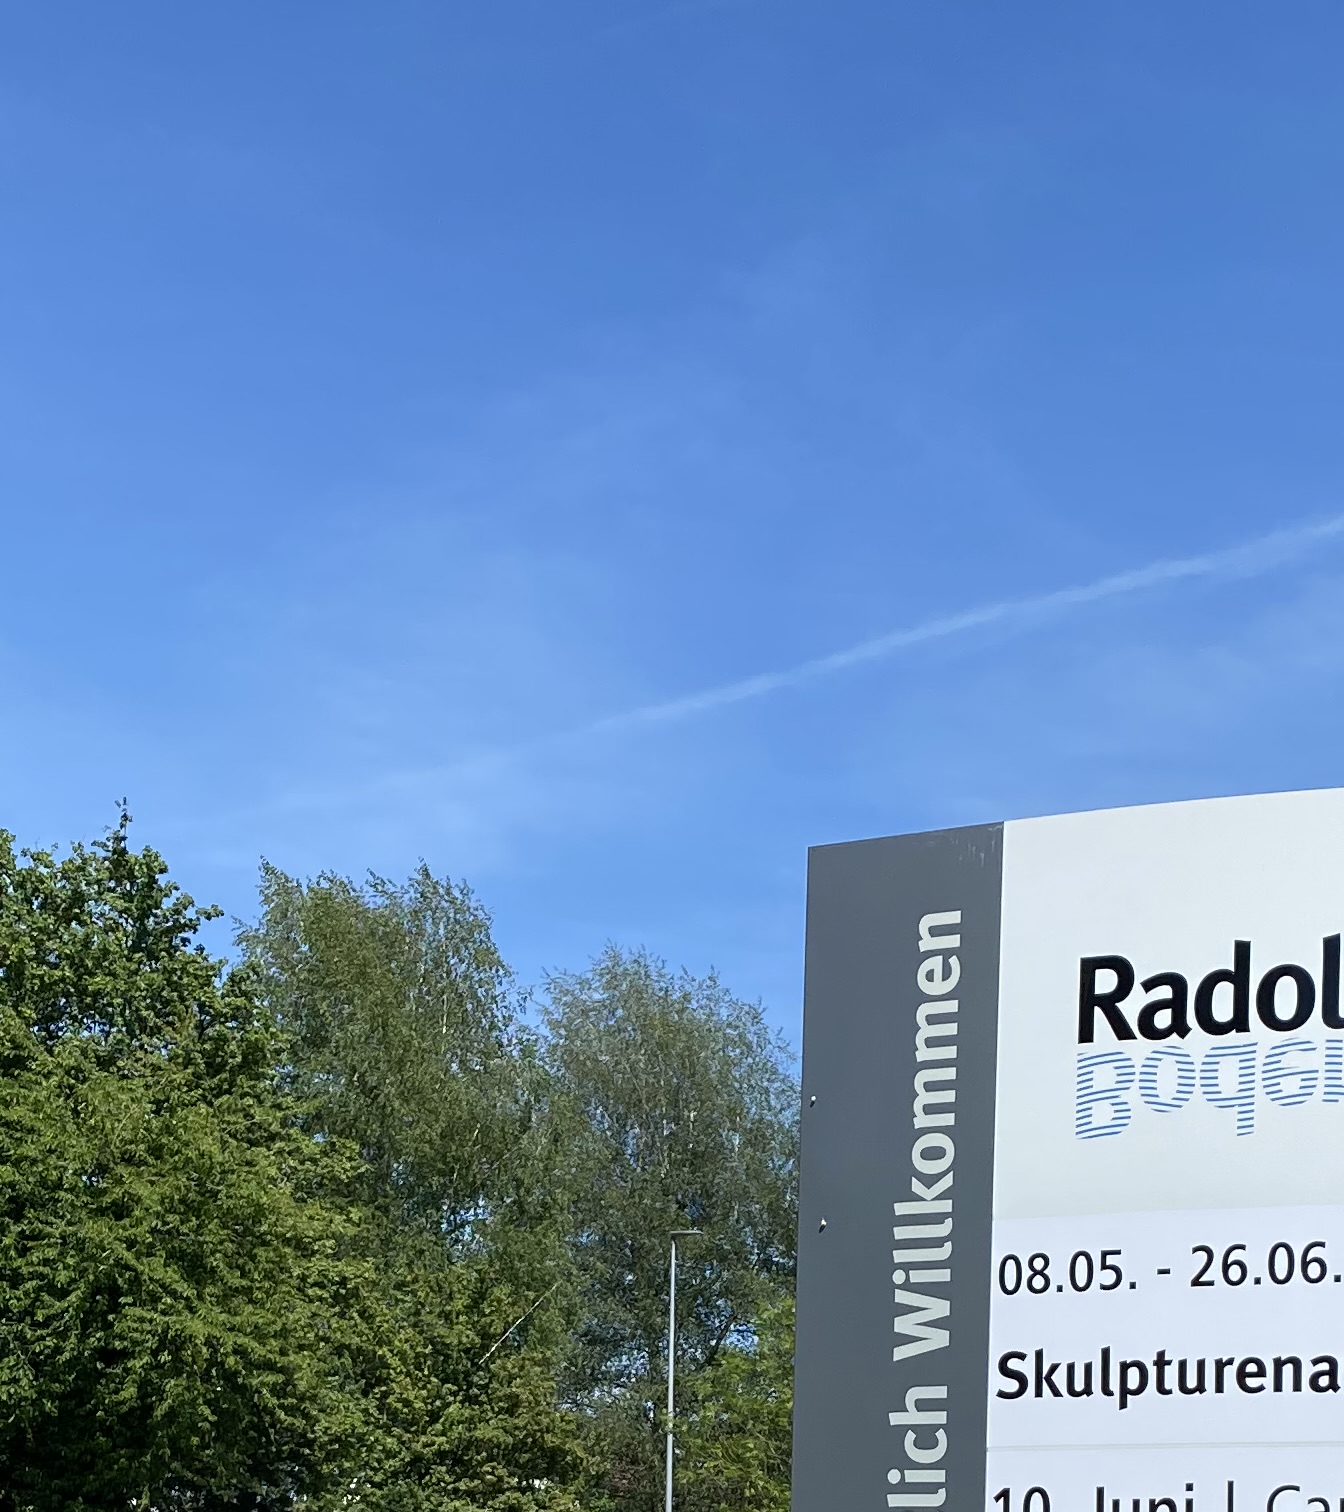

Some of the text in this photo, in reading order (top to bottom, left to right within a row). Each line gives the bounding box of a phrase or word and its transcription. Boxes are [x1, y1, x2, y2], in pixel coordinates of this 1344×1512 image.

[891, 909, 963, 1363] Willkommen
[998, 1249, 1138, 1296] 08.05.
[1190, 1241, 1343, 1287] 26.06.
